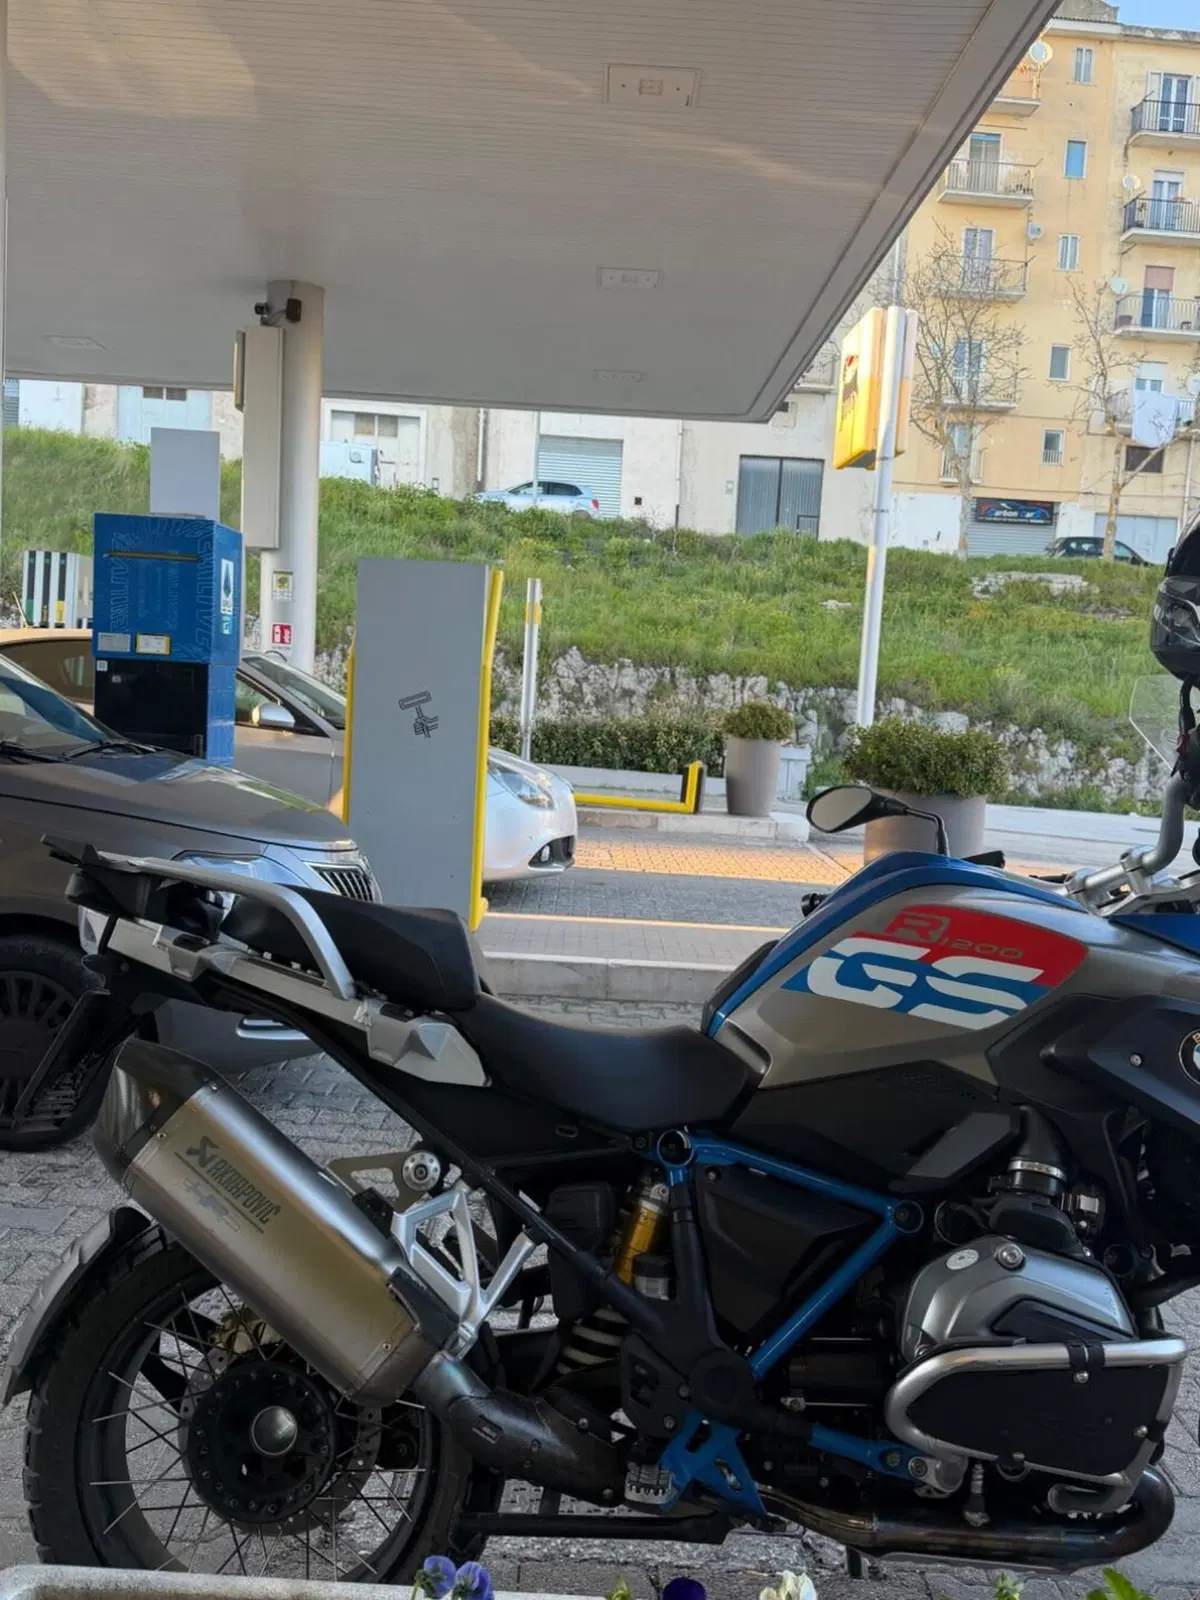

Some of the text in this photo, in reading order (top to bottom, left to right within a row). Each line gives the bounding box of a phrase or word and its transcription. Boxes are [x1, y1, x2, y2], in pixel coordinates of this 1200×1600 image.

[884, 911, 1024, 960] R 1200
[807, 937, 1044, 1030] GS
